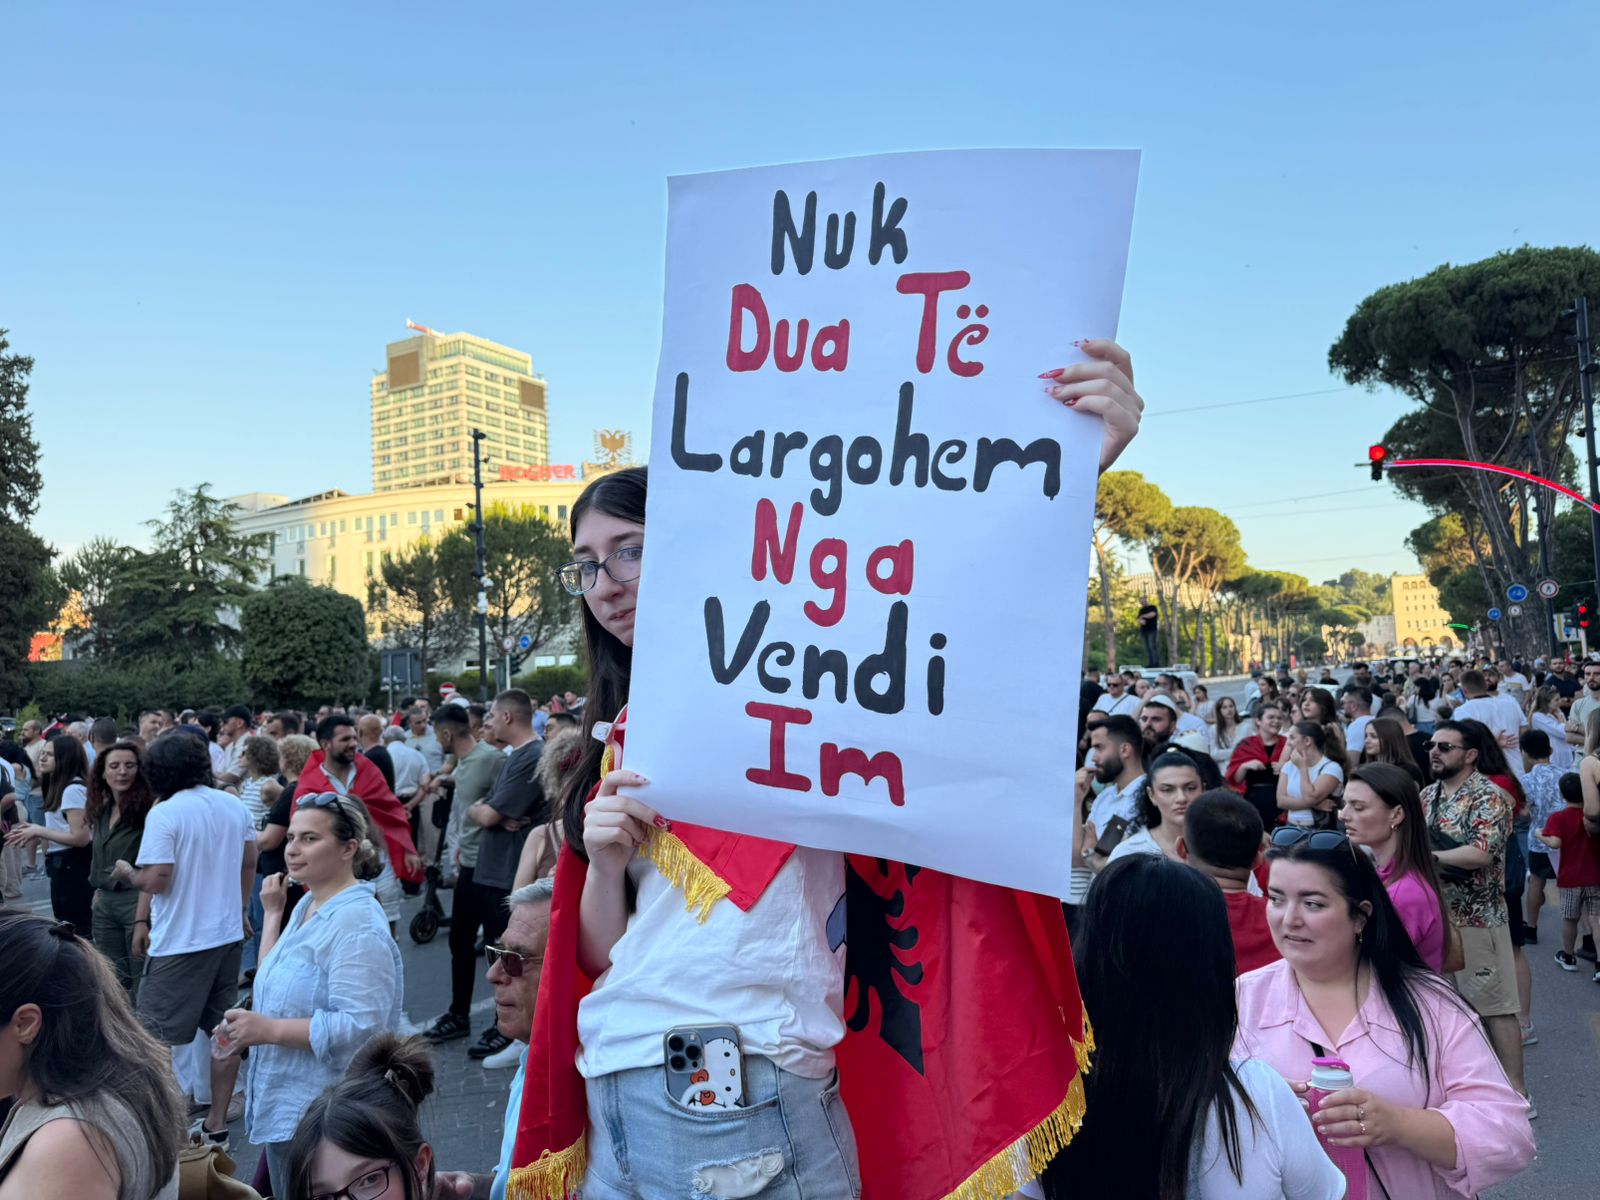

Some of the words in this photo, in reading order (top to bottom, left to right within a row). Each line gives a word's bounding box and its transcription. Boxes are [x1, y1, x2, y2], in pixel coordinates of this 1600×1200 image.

[771, 182, 908, 275] Nuk
[727, 284, 850, 372] Dua
[896, 271, 989, 377] Të
[671, 372, 1061, 516] Largohem
[752, 498, 913, 627] Nga
[704, 597, 947, 716] Vendi
[745, 701, 905, 806] Im
